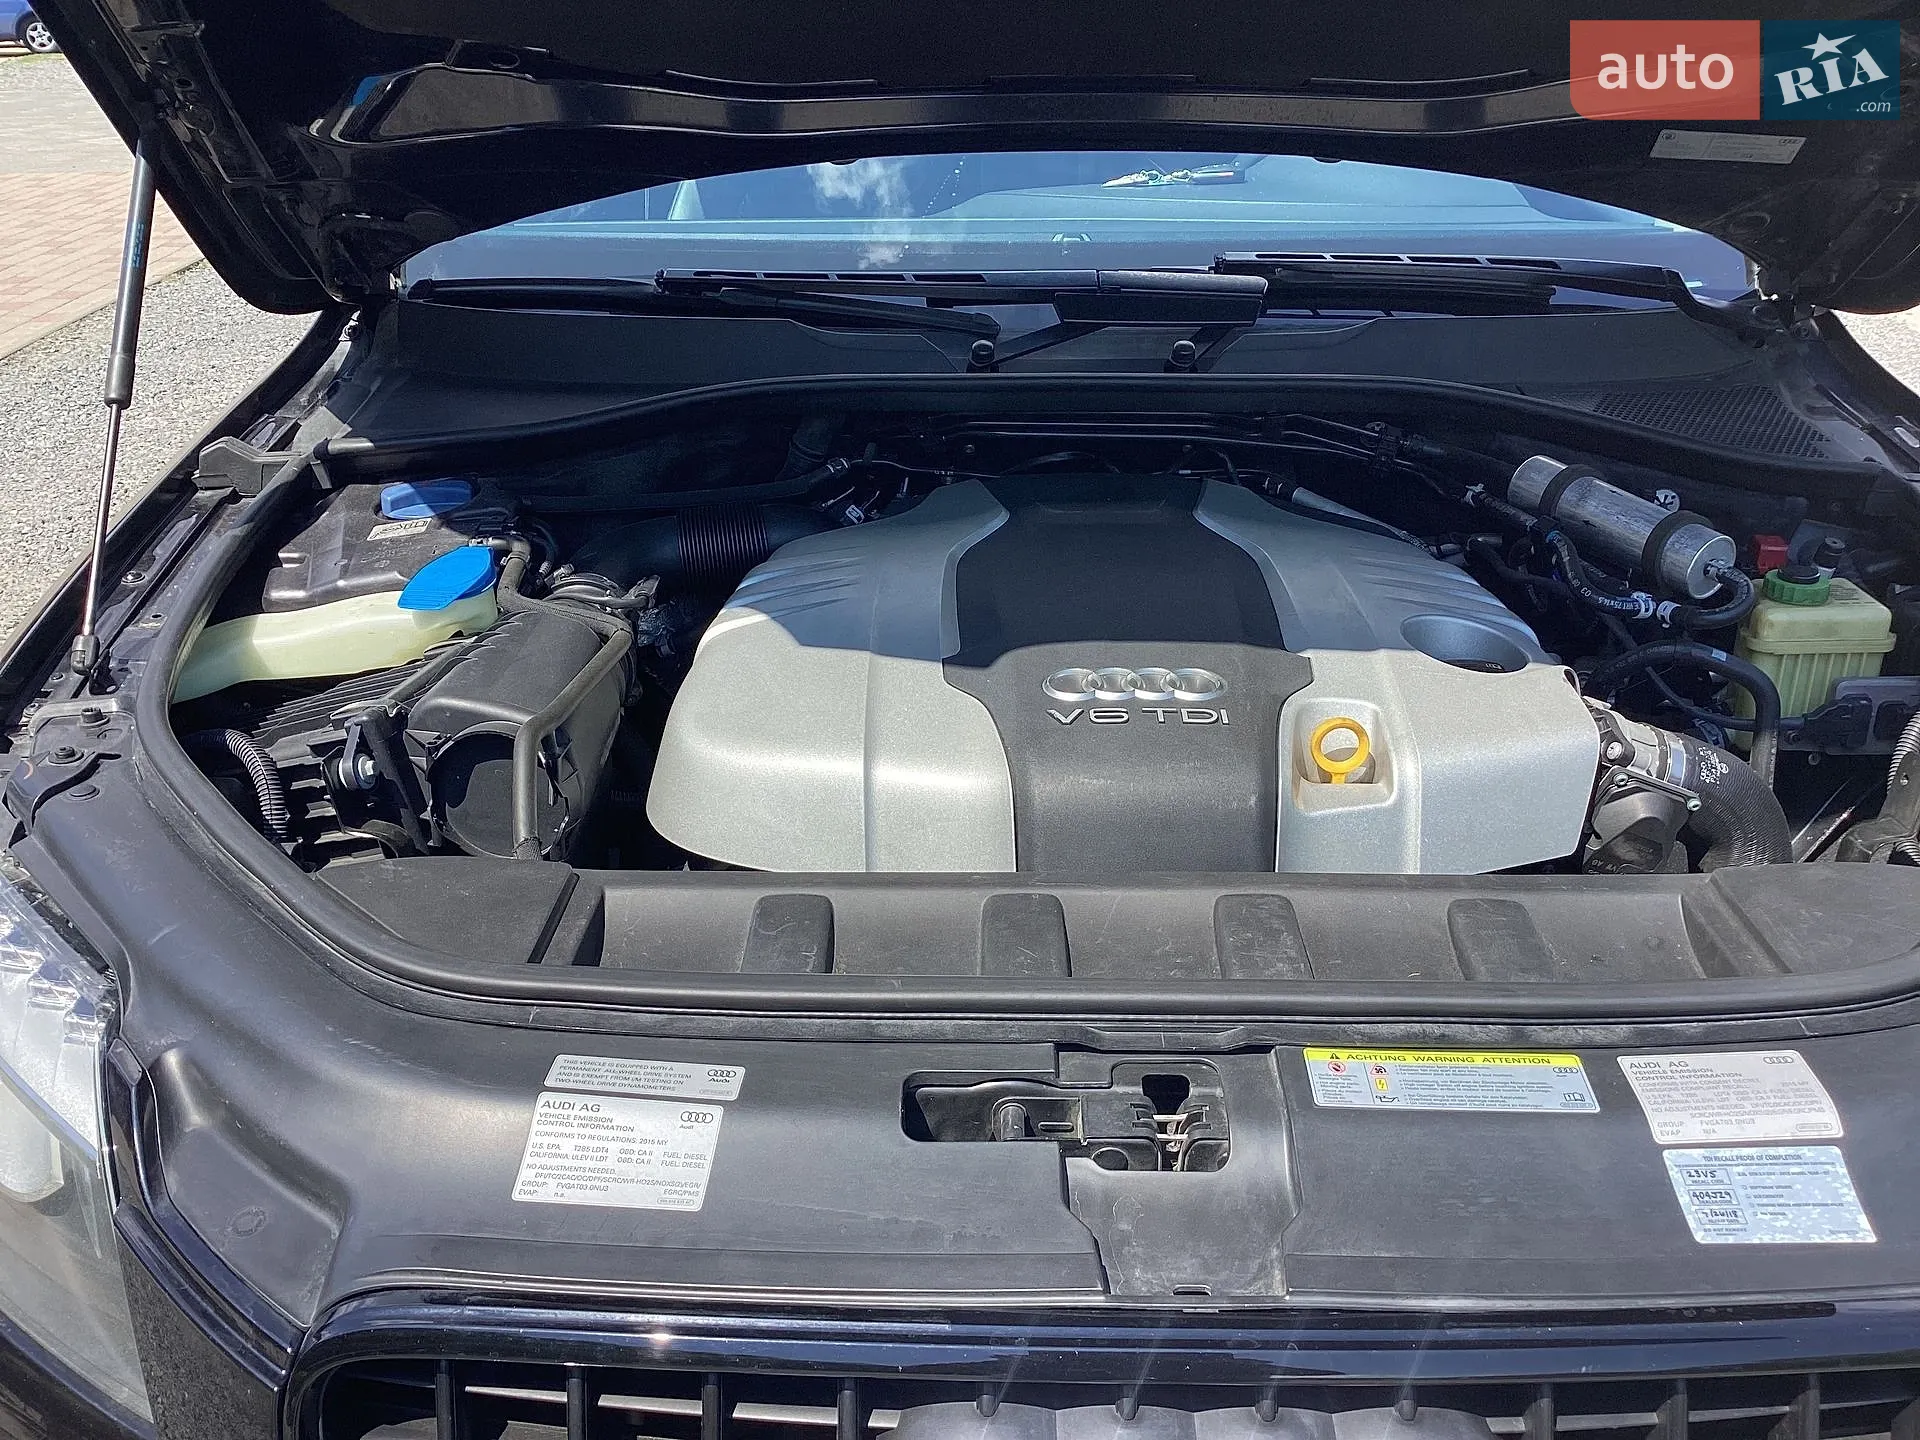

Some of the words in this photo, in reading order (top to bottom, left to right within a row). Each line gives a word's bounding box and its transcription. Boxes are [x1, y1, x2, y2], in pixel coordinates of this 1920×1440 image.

[1047, 707, 1129, 725] V6
[1142, 707, 1229, 725] TDI
[1412, 1055, 1475, 1063] WARNING
[1630, 1061, 1661, 1069] AUDI
[1669, 1060, 1689, 1068] AG
[555, 1078, 595, 1086] TWO-WHEEL
[618, 1082, 676, 1091] DYNAMOMETERS
[541, 1100, 575, 1110] AUDI
[579, 1103, 601, 1113] AG
[1664, 1104, 1715, 1113] ADJUSTMENTS
[539, 1112, 572, 1120] VEHICLE
[573, 1115, 614, 1123] EMISSION
[536, 1119, 574, 1128] CONTROL
[577, 1123, 635, 1132] INFORMATION
[535, 1130, 575, 1139] CONFORMS
[577, 1132, 587, 1140] TO
[684, 1153, 708, 1161] DIESEL
[538, 1164, 587, 1173] ADJUSTMENTS
[682, 1161, 706, 1169] DIESEL
